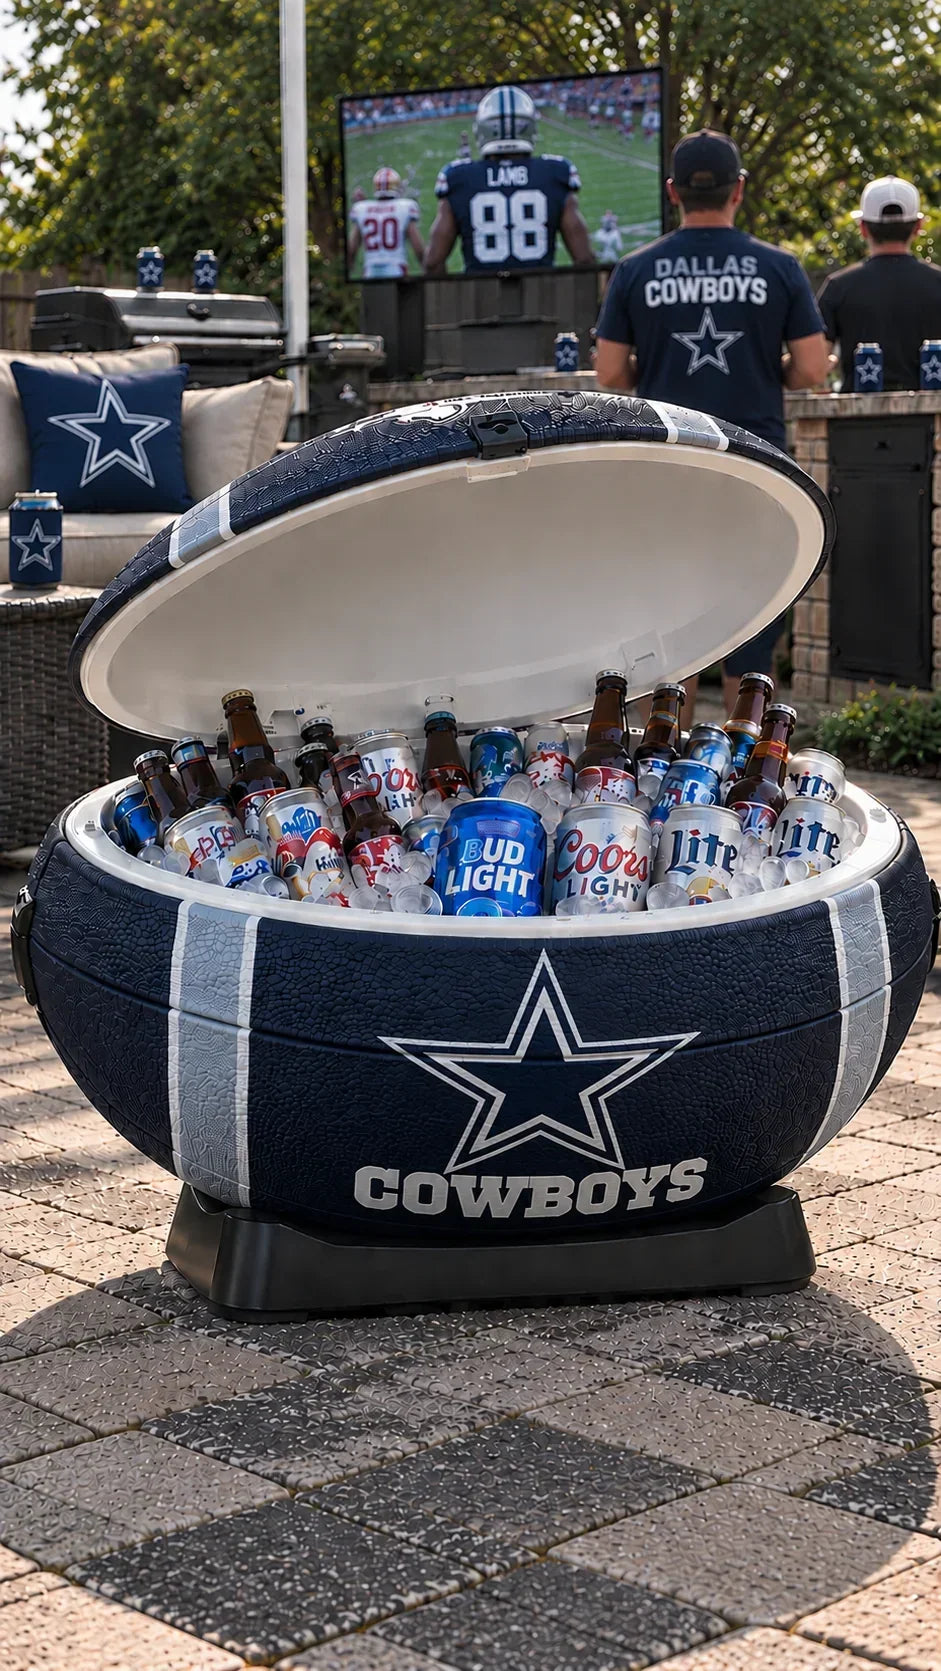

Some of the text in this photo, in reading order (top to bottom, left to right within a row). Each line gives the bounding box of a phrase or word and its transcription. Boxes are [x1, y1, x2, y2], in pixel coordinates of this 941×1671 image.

[486, 166, 528, 187] LAMB
[364, 217, 398, 250] 20
[469, 189, 549, 264] 88
[655, 255, 758, 279] DALLAS
[644, 275, 768, 308] COWBOYS
[459, 837, 525, 865] BUD
[554, 828, 648, 883] Coors
[664, 828, 738, 879] Lite
[445, 863, 536, 898] LIGHT
[354, 1156, 708, 1218] COWBOYS
